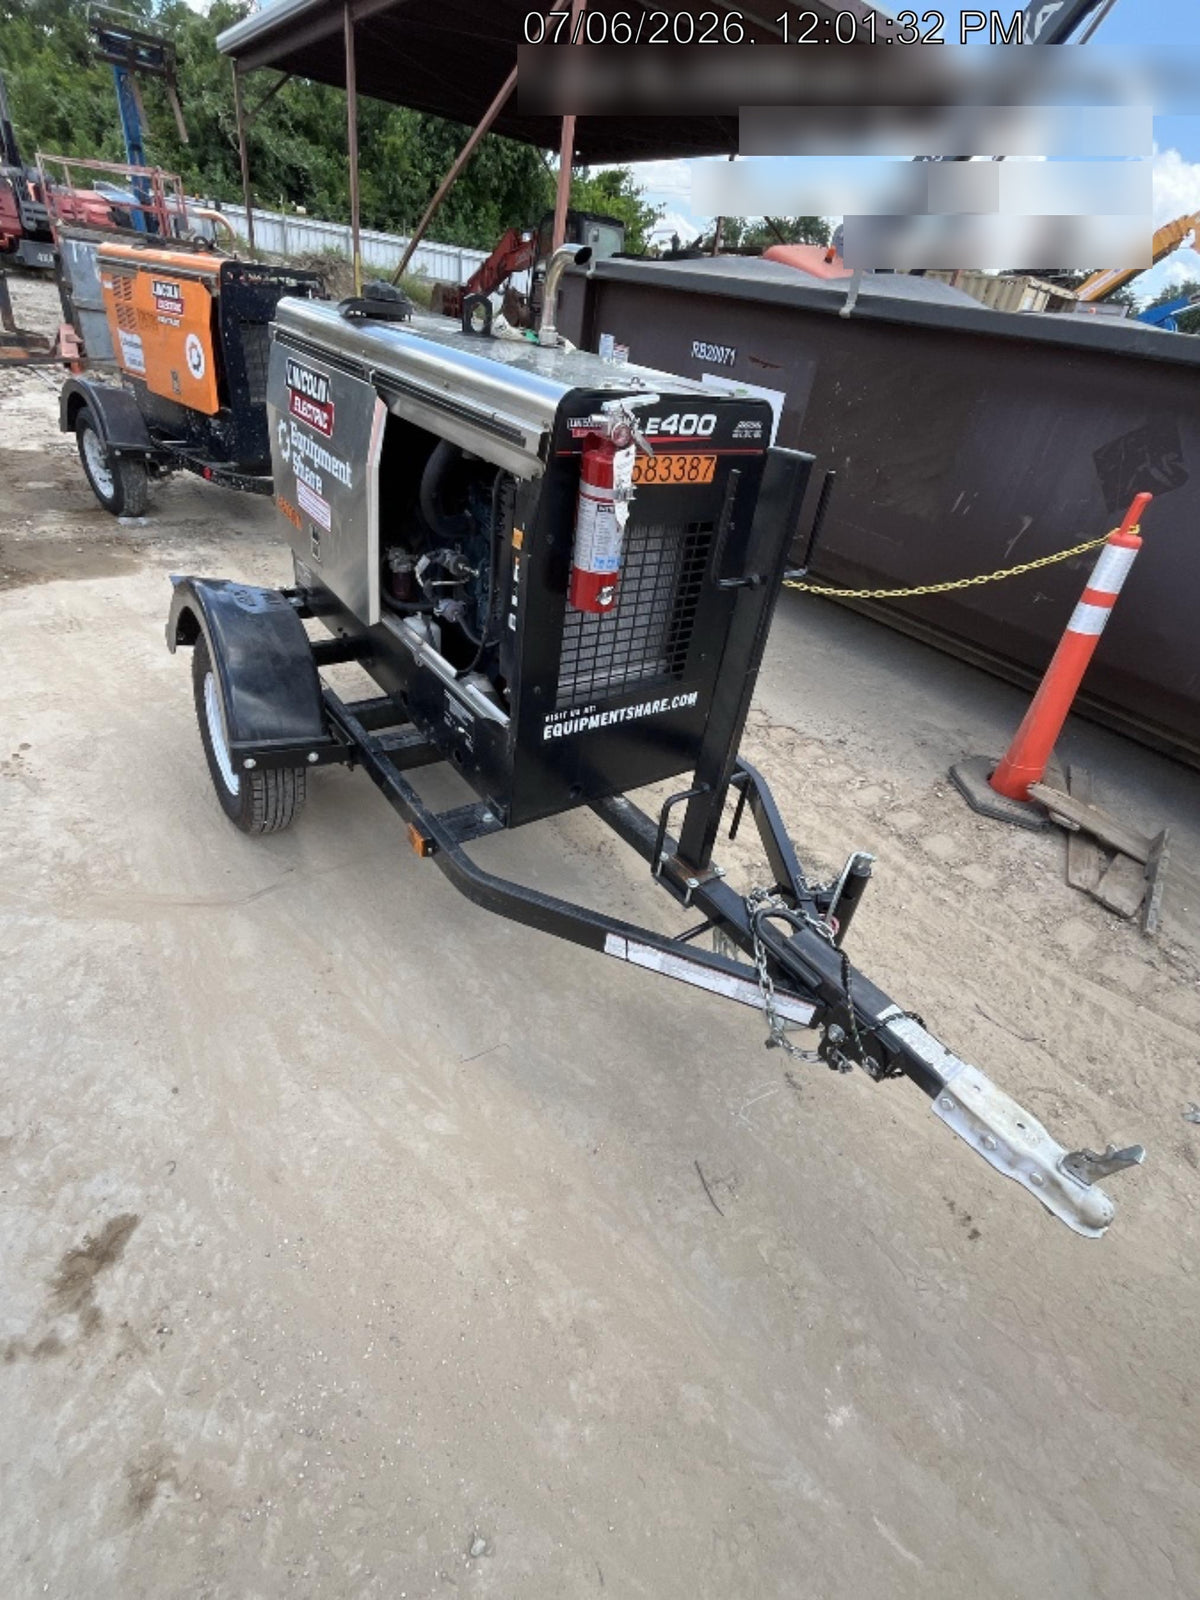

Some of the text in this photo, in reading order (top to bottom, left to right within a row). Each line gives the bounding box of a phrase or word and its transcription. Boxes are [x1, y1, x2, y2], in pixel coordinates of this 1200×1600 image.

[287, 364, 327, 403] LINCOLN
[289, 420, 353, 490] Equipment
[292, 451, 323, 496] Share
[543, 691, 698, 740] EQUIPMENTSHARE.COM
